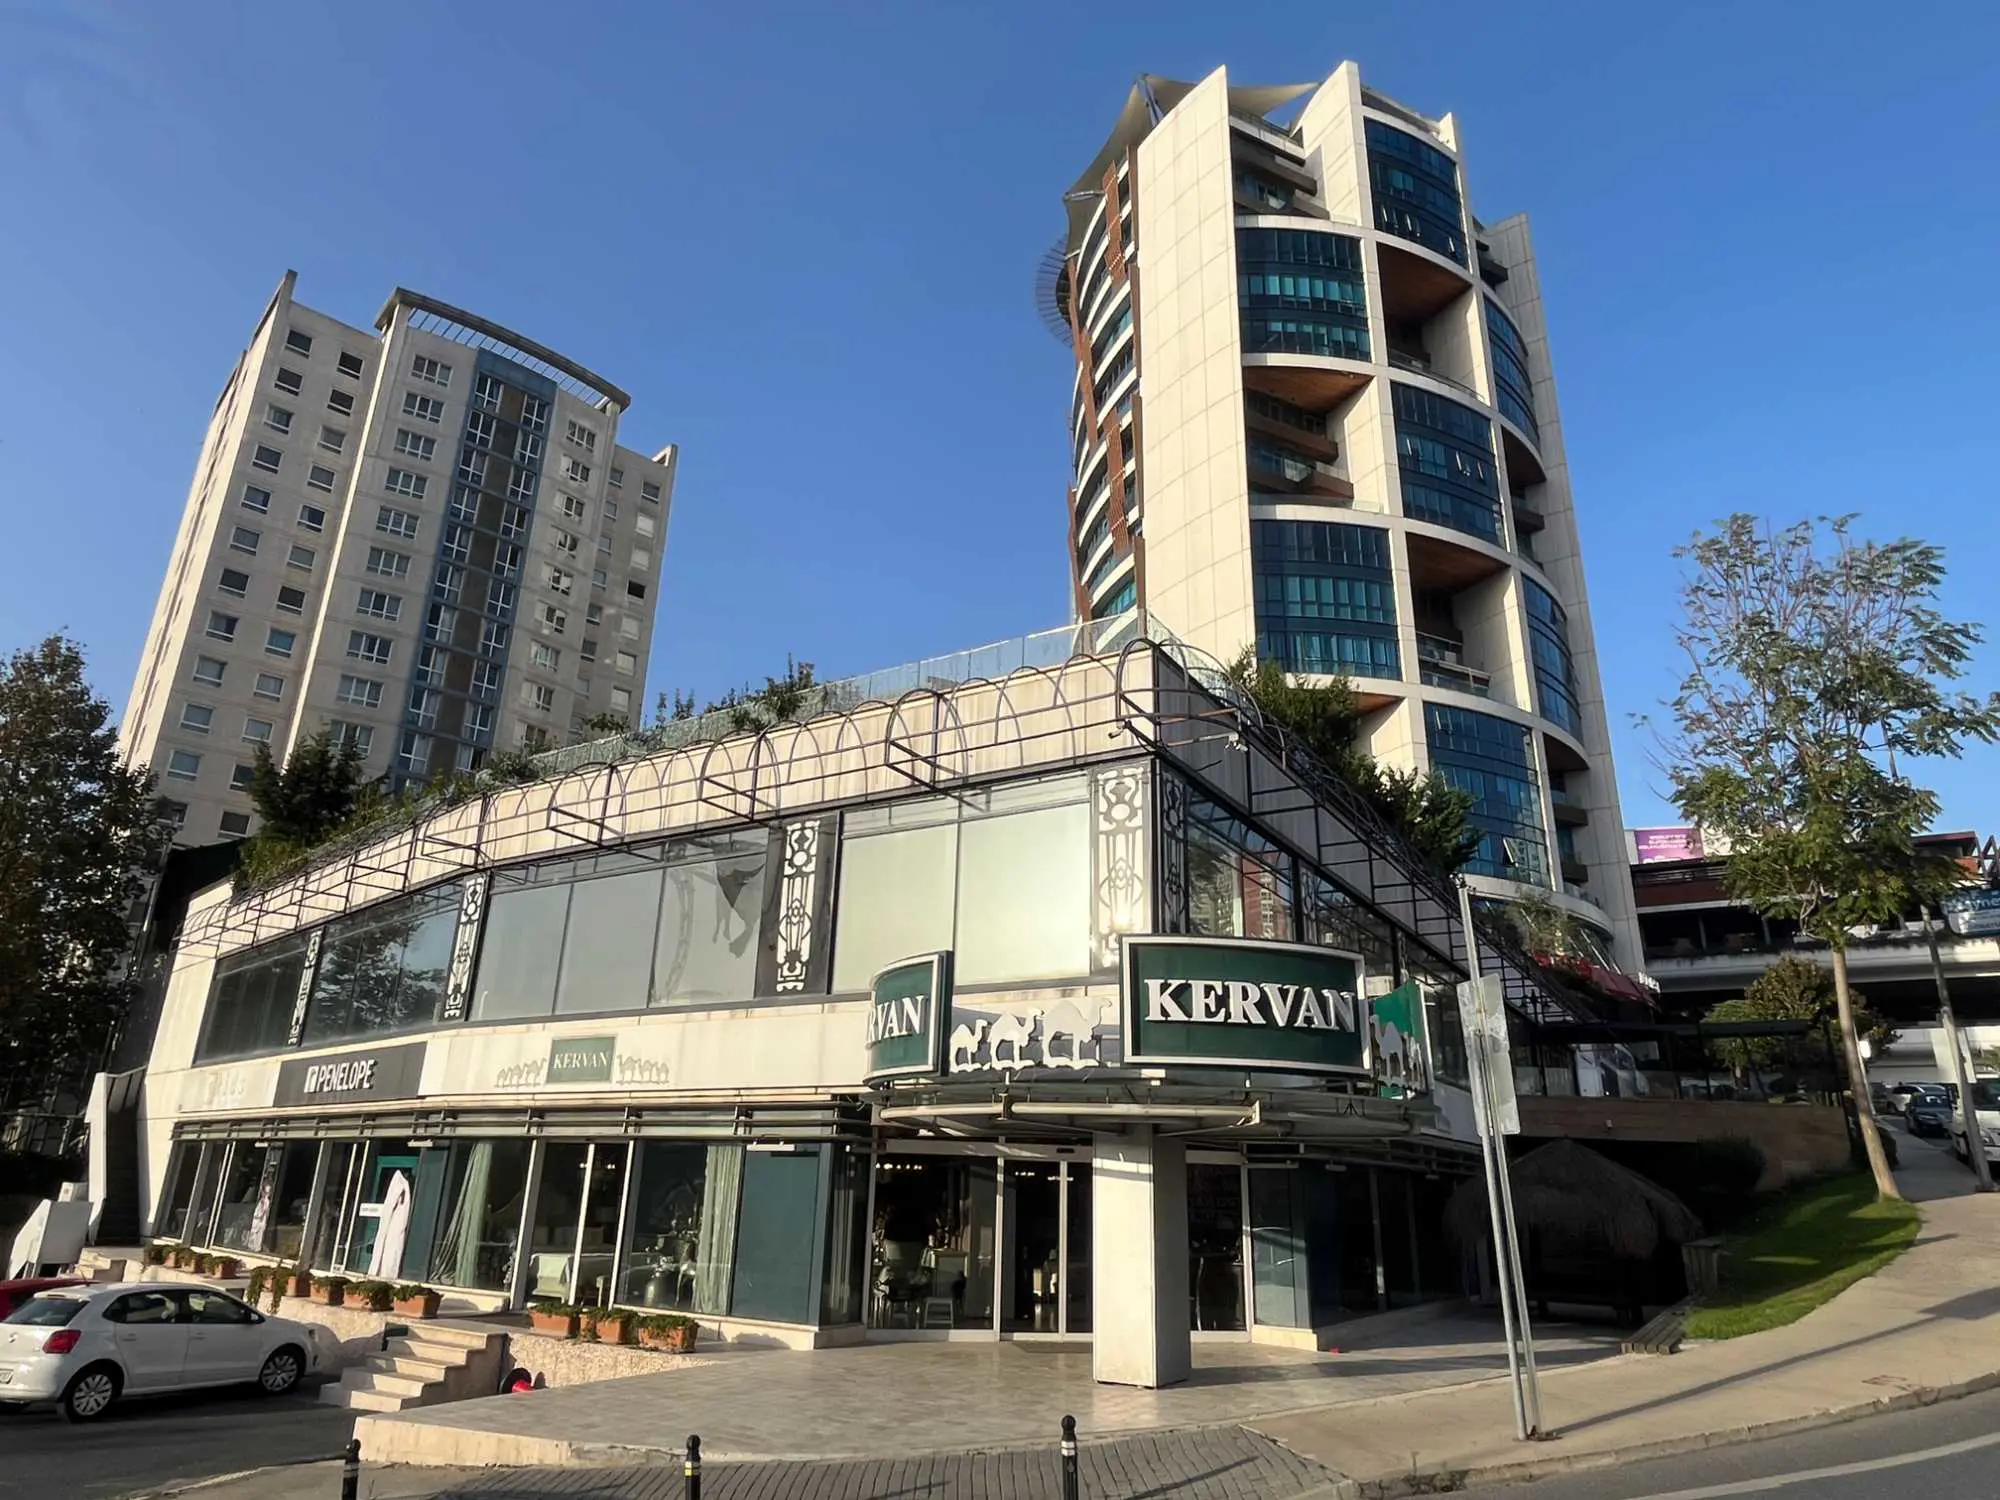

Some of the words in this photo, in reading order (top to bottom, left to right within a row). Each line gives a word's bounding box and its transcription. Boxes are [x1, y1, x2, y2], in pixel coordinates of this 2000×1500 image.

[1144, 978, 1355, 1033] KERVAN
[316, 1059, 376, 1093] PENELOPE
[553, 1051, 610, 1069] KERVAN
